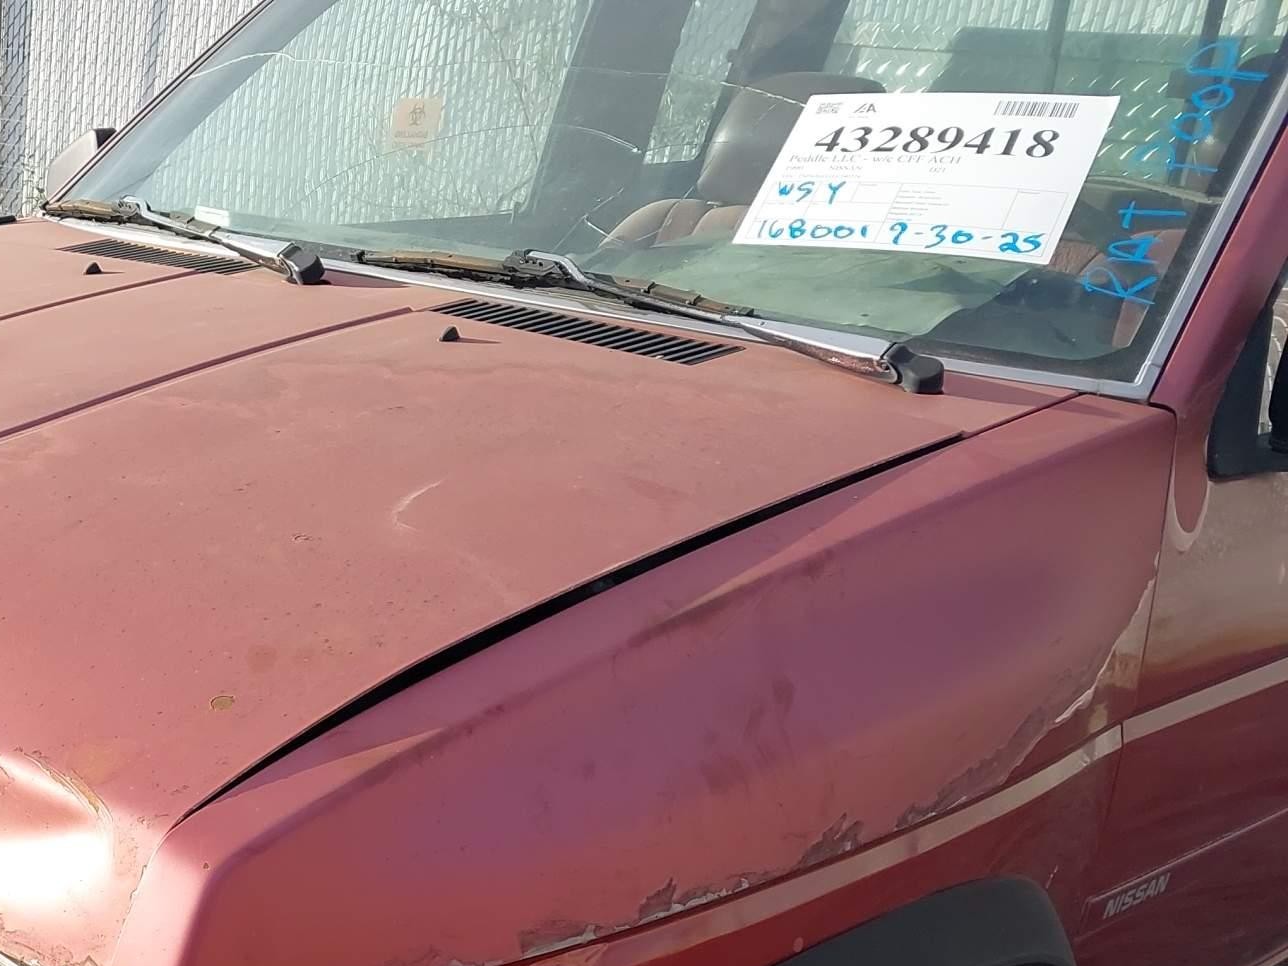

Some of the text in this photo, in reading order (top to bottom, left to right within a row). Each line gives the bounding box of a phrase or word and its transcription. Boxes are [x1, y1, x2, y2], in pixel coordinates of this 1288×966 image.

[814, 126, 1061, 158] 43289418
[1082, 201, 1187, 304] RAT
[1103, 873, 1171, 920] NISSAN
